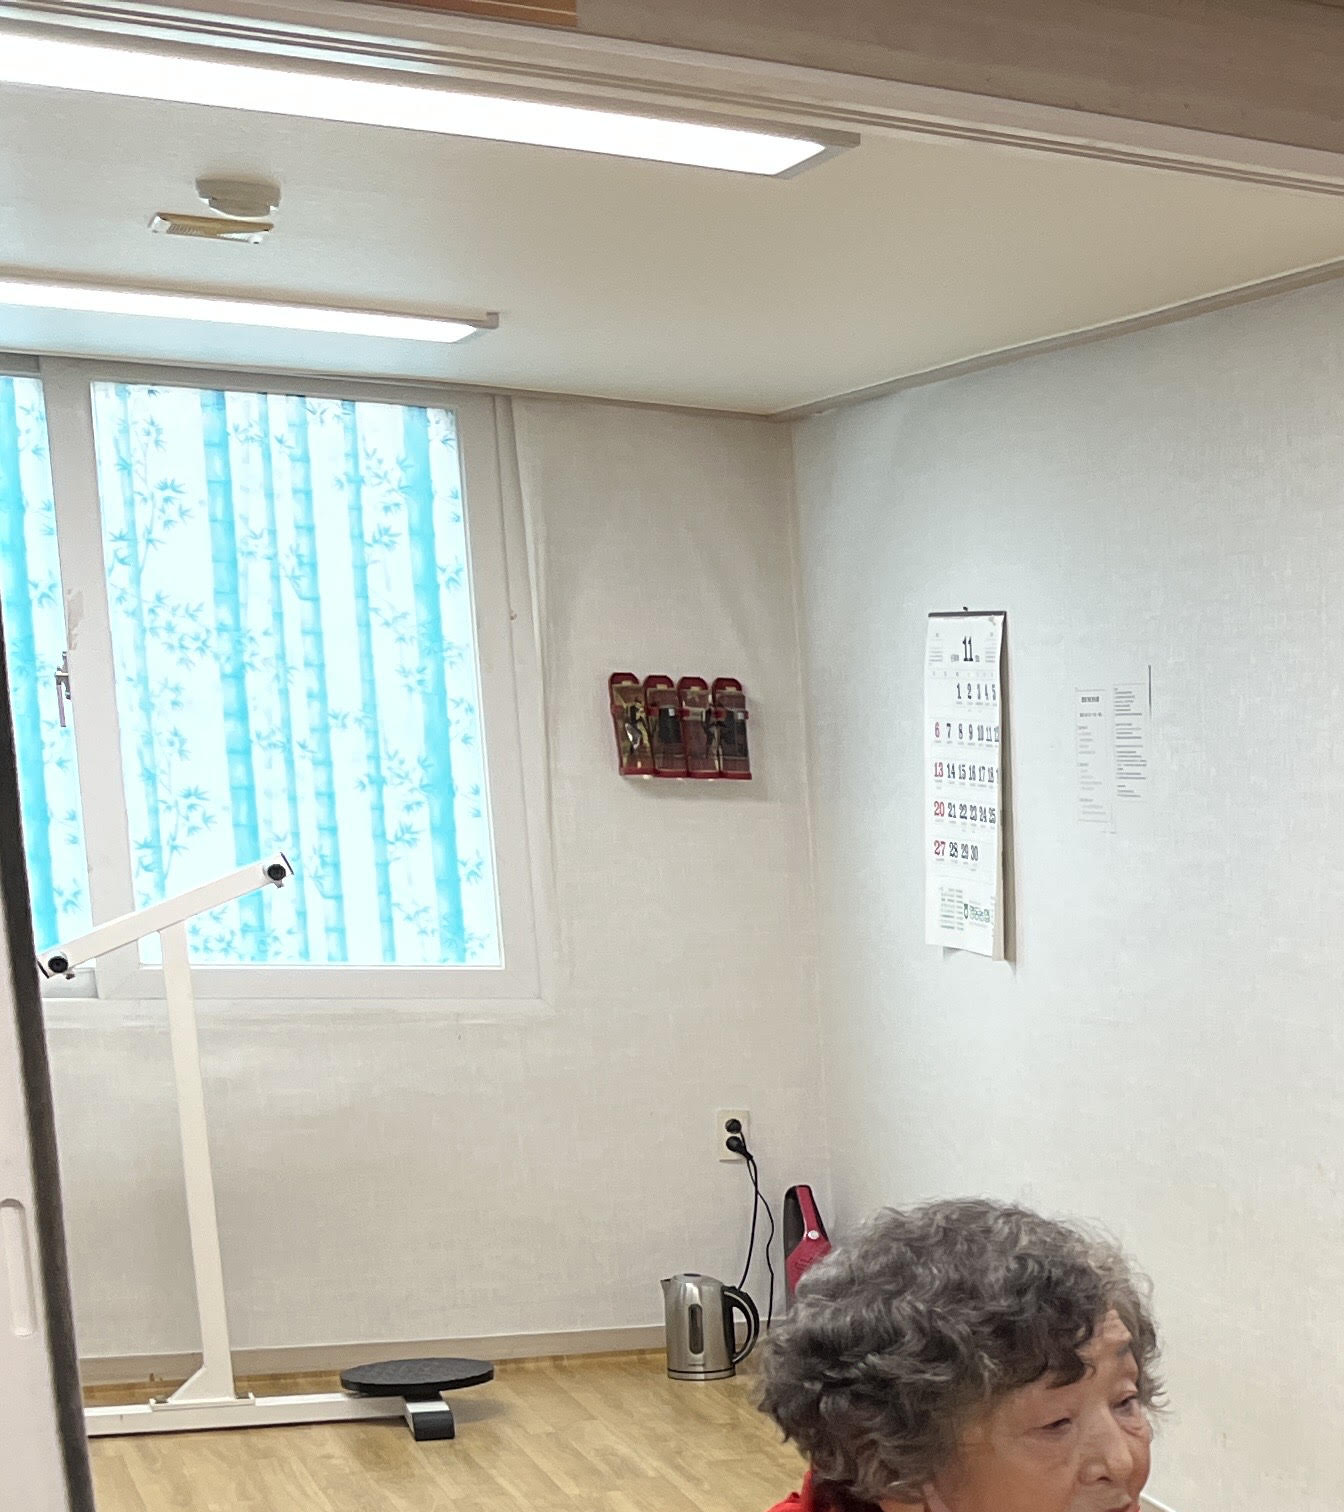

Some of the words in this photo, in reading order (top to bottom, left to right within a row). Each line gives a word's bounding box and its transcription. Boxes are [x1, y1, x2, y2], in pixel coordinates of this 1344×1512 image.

[962, 635, 974, 661] 11
[956, 682, 962, 700] 1
[967, 682, 972, 700] 2
[934, 721, 941, 738] 6
[946, 722, 952, 739] 7
[934, 761, 944, 778] 13
[946, 762, 956, 779] 14
[958, 764, 967, 780] 15
[933, 800, 945, 817] 20
[947, 802, 957, 818] 21
[959, 803, 968, 820] 22
[933, 839, 946, 856] 27
